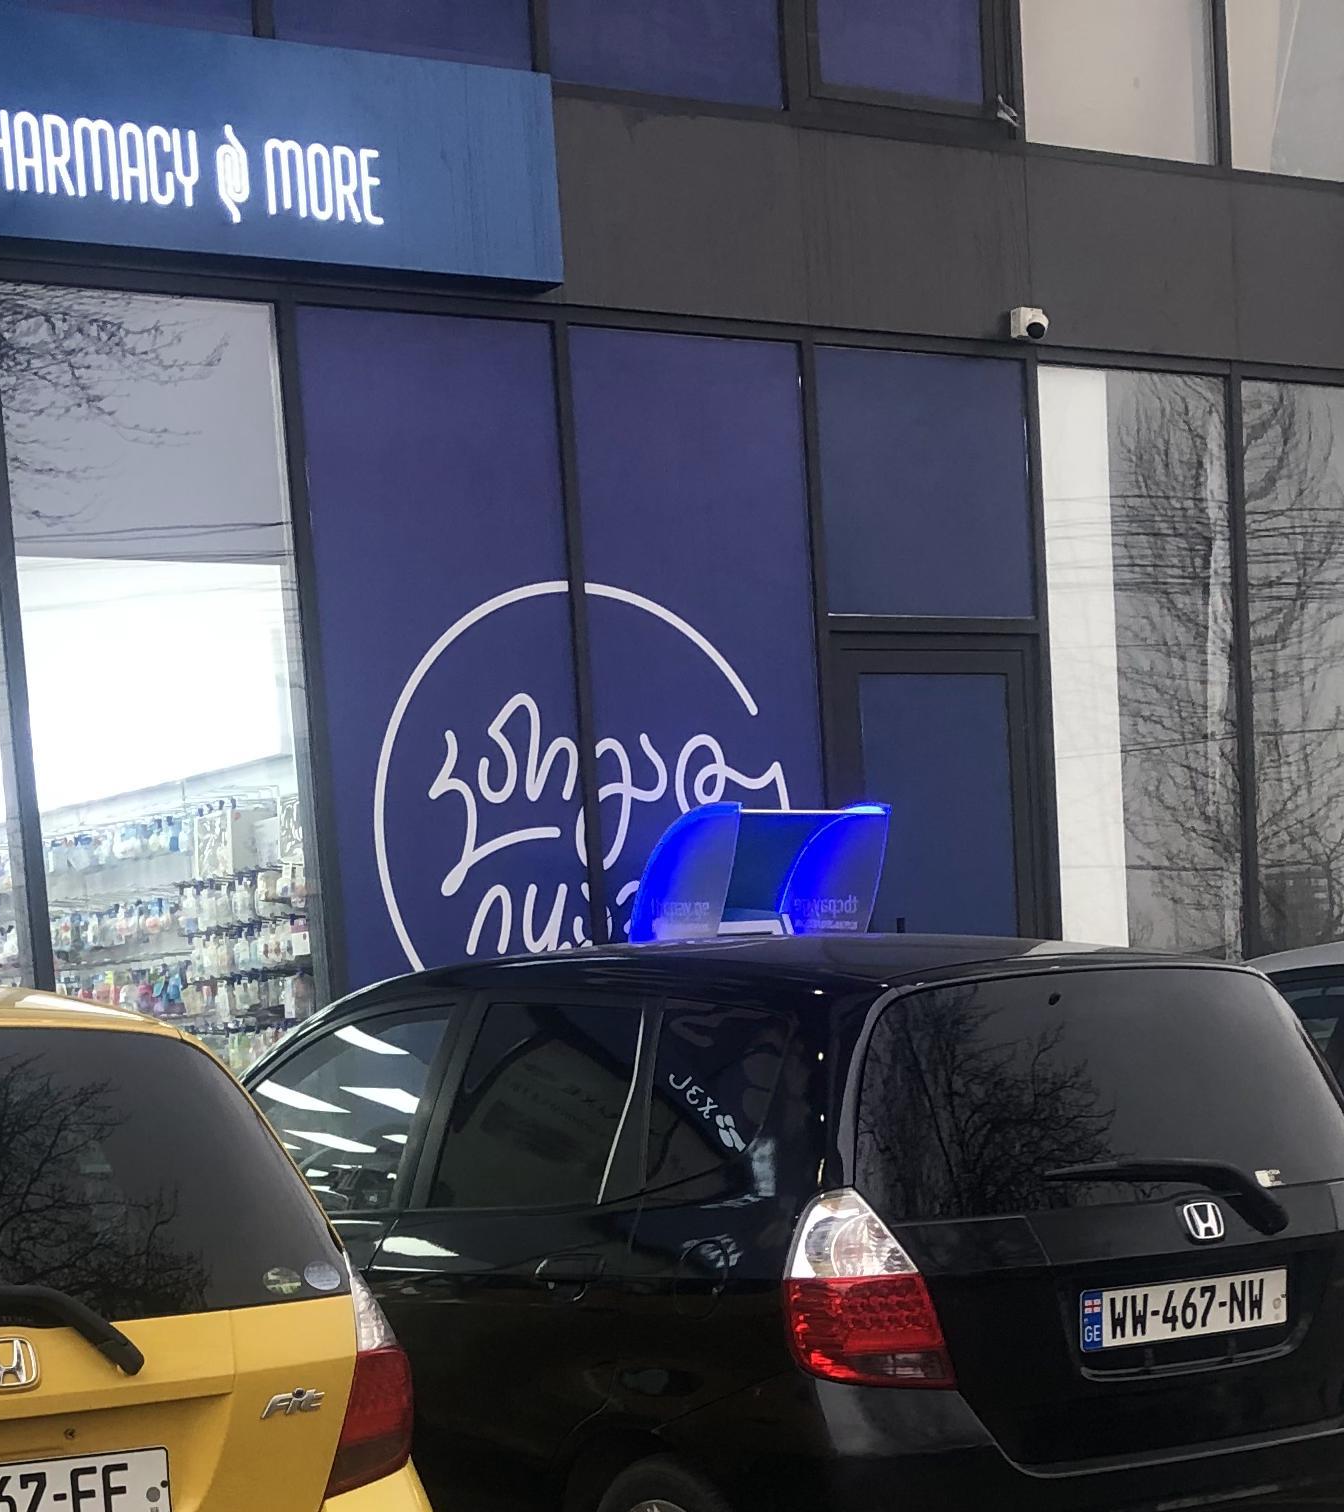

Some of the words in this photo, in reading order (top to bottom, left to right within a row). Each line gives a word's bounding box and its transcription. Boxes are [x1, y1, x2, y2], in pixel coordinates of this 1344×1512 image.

[264, 137, 385, 226] MORE
[1084, 1325, 1102, 1343] GE
[1109, 1278, 1265, 1340] WW-467-NW
